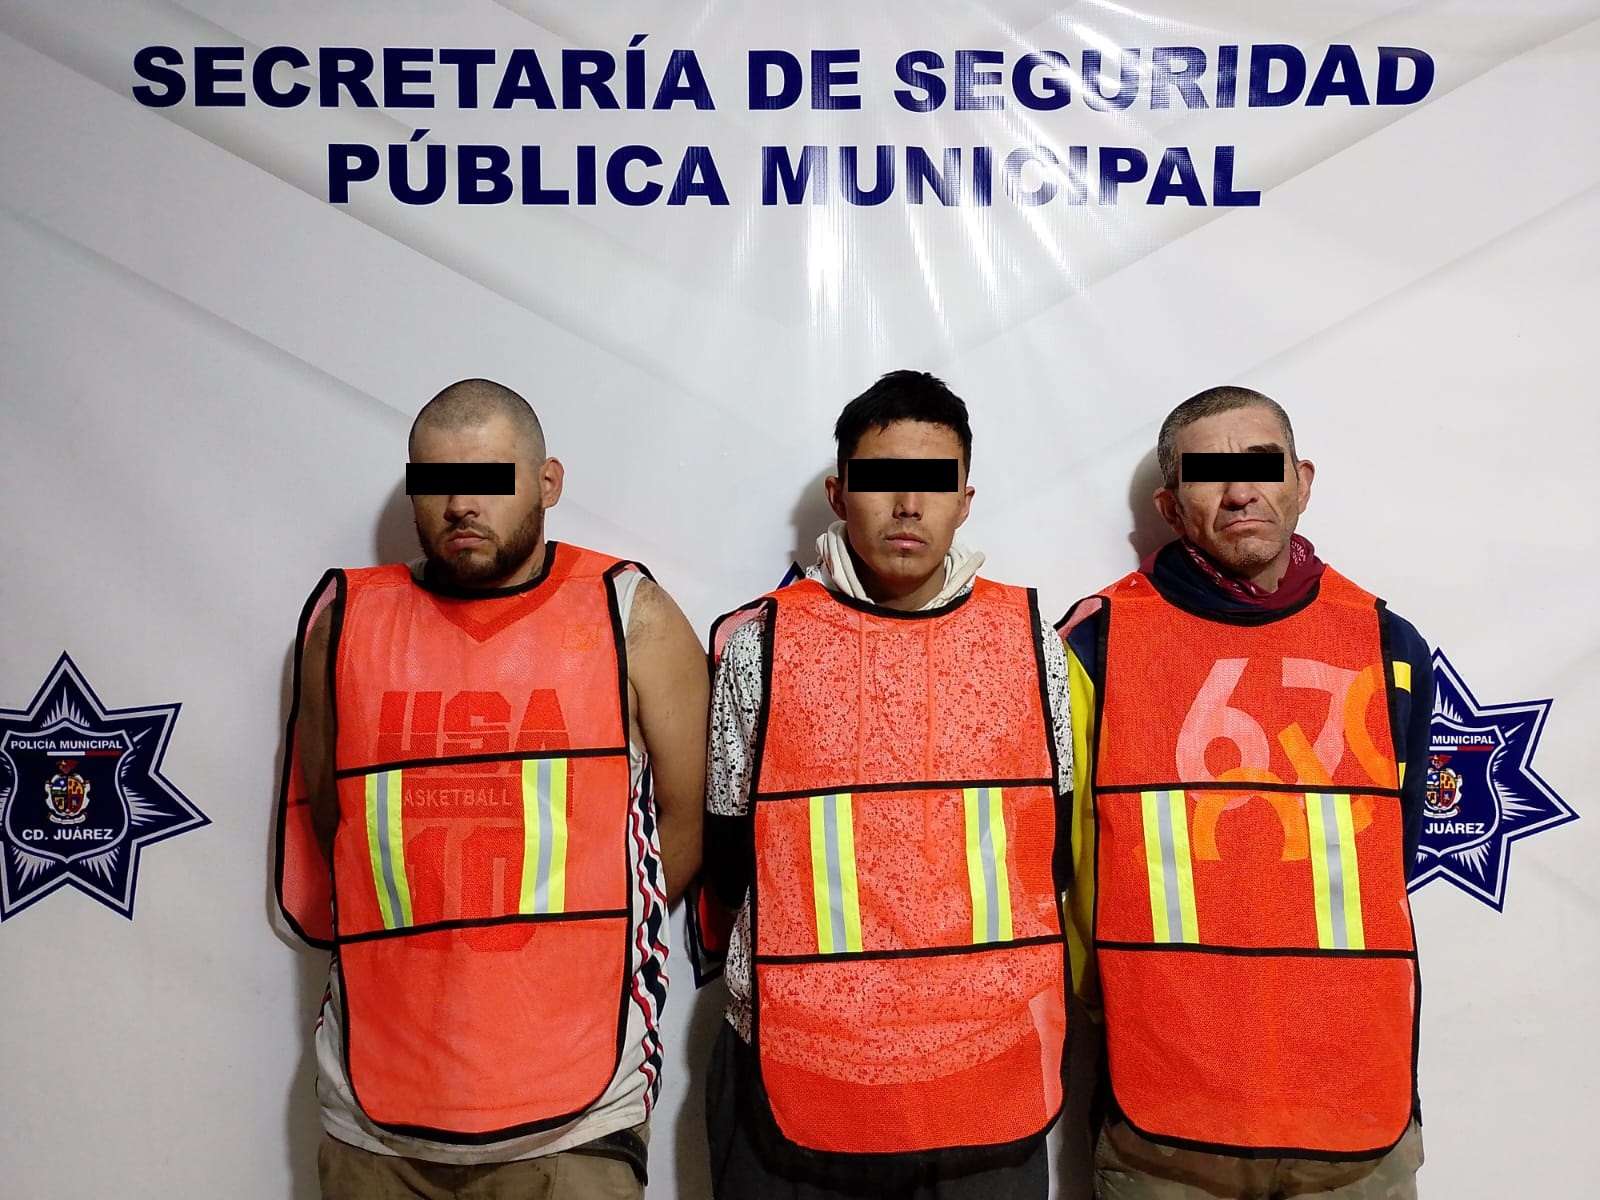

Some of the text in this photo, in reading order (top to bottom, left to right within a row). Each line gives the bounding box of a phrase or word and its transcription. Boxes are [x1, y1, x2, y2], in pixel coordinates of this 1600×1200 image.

[132, 34, 1435, 112] SECRETARÍA DE SEGURIDAD
[328, 129, 1261, 207] PÚBLICA MUNICIPAL
[377, 688, 575, 775] USA
[1176, 656, 1361, 810] 67
[1432, 734, 1496, 746] MUNICIPAL
[10, 738, 124, 751] POLICÍA MUNICIPAL
[403, 787, 513, 808] ASKETBALL
[21, 825, 114, 841] CD. JUÁREZ
[1424, 819, 1486, 835] JUÁREZ
